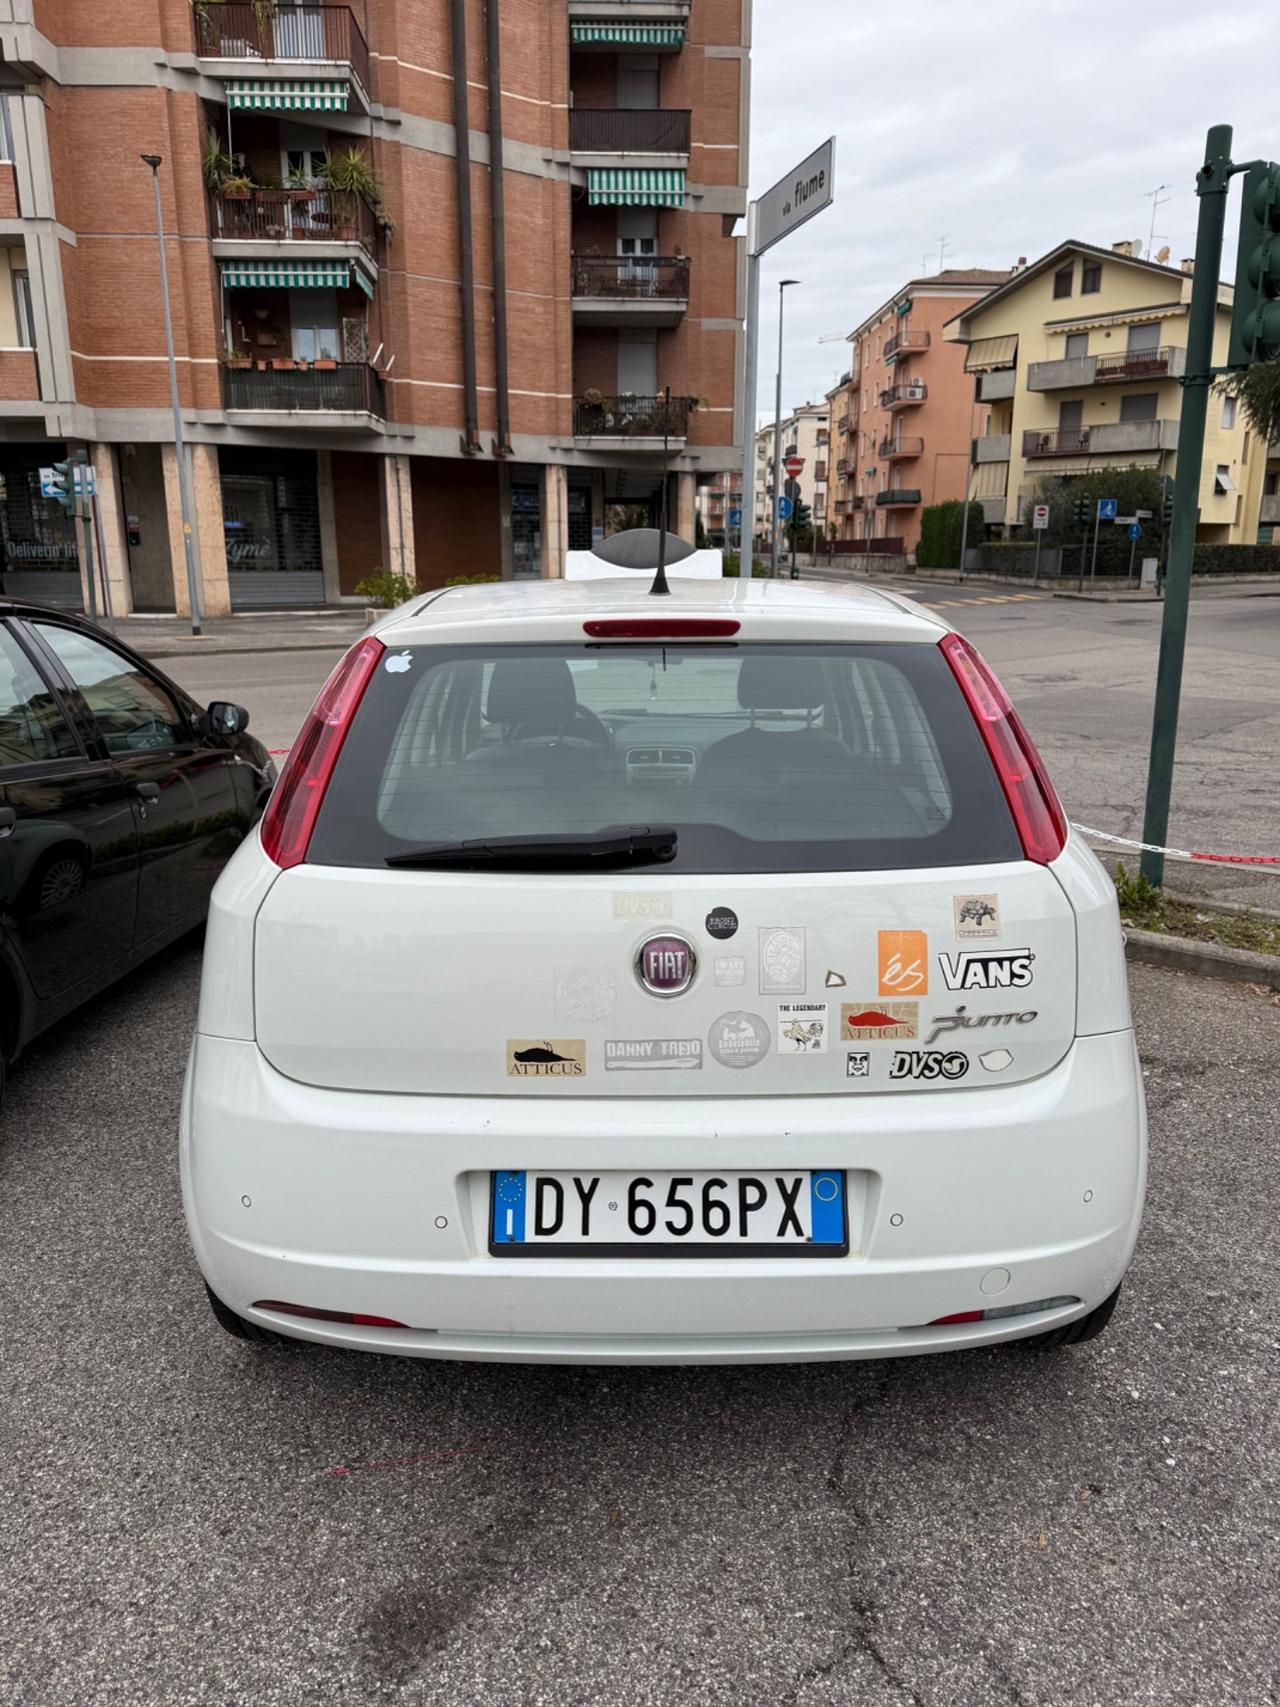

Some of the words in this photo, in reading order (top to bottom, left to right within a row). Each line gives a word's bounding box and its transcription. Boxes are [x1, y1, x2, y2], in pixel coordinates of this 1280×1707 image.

[794, 169, 825, 208] fiume
[649, 951, 685, 979] FIAT
[938, 948, 1034, 990] VANS
[845, 1026, 915, 1039] ATTICUS
[606, 1042, 653, 1057] DANNY
[511, 1063, 582, 1075] ATTICUS
[891, 1051, 945, 1079] DVS
[534, 1177, 600, 1236] DY
[627, 1177, 805, 1236] 656PX
